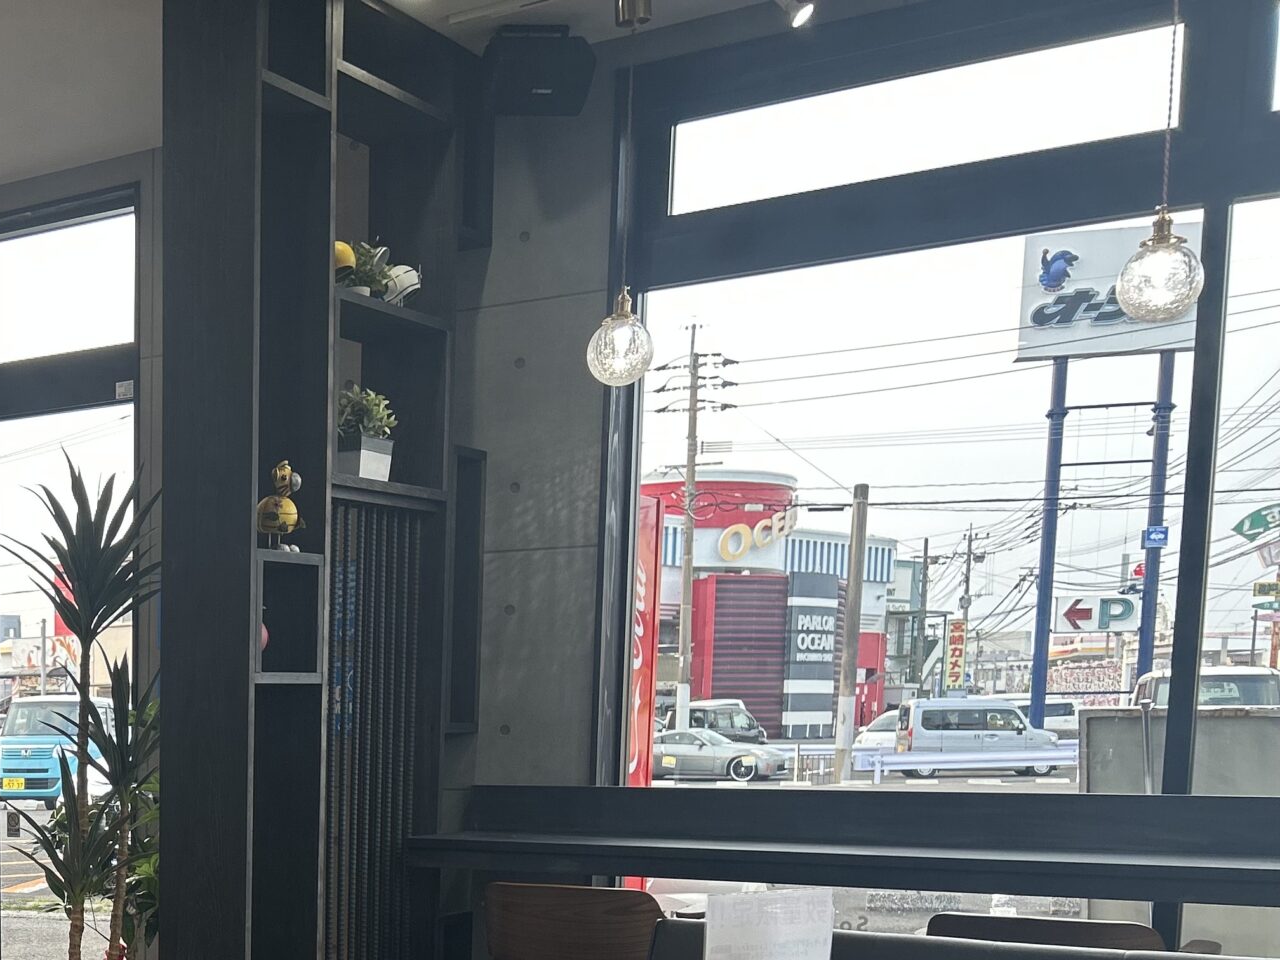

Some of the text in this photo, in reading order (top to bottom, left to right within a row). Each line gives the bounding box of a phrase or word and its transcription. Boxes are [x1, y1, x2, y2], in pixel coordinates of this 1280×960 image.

[1097, 597, 1135, 630] P
[797, 614, 835, 632] PARLOR
[797, 633, 834, 651] OCEAN
